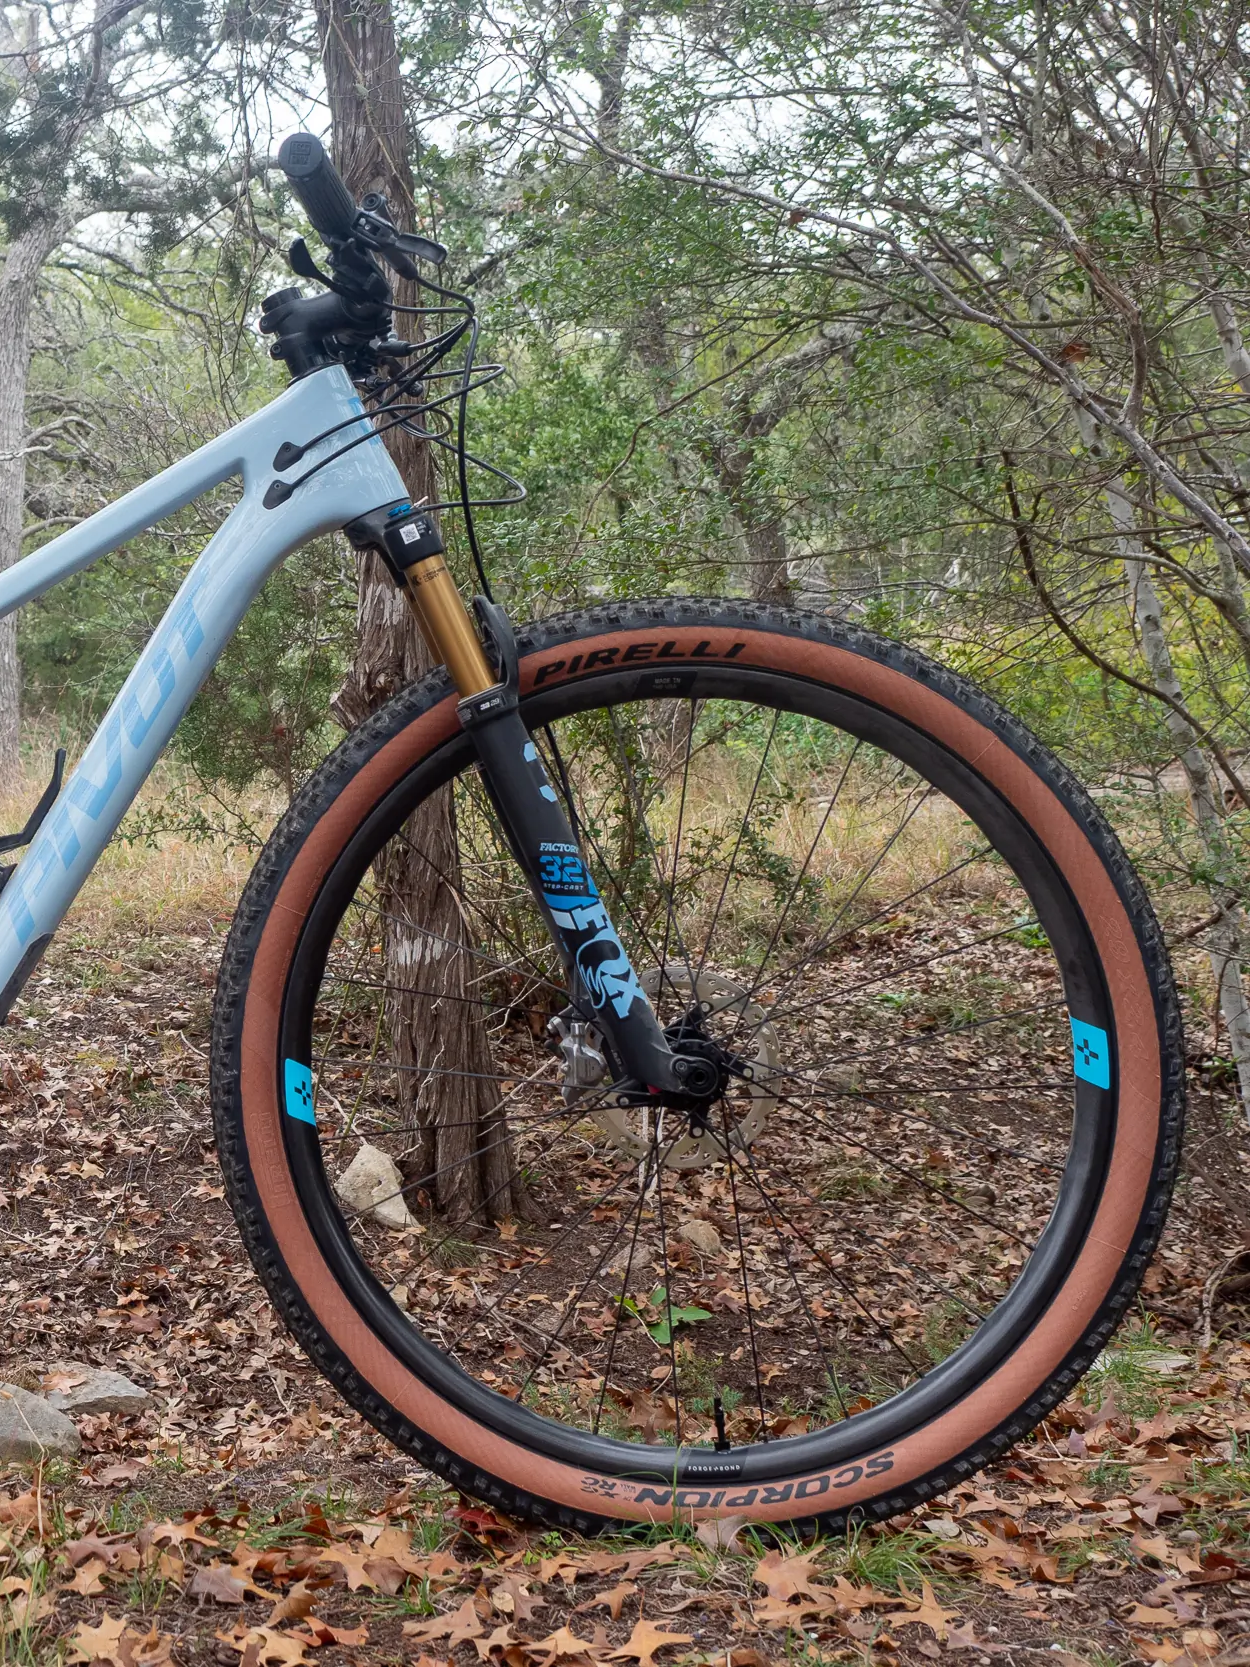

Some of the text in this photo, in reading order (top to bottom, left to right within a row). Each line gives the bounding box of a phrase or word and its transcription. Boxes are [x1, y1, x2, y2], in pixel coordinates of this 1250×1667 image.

[533, 640, 746, 687] PIRELLI
[5, 563, 211, 947] PIVOT
[540, 855, 584, 883] 32
[570, 899, 650, 1020] FOX
[580, 1476, 617, 1491] RC
[633, 1451, 895, 1509] SCORPION
